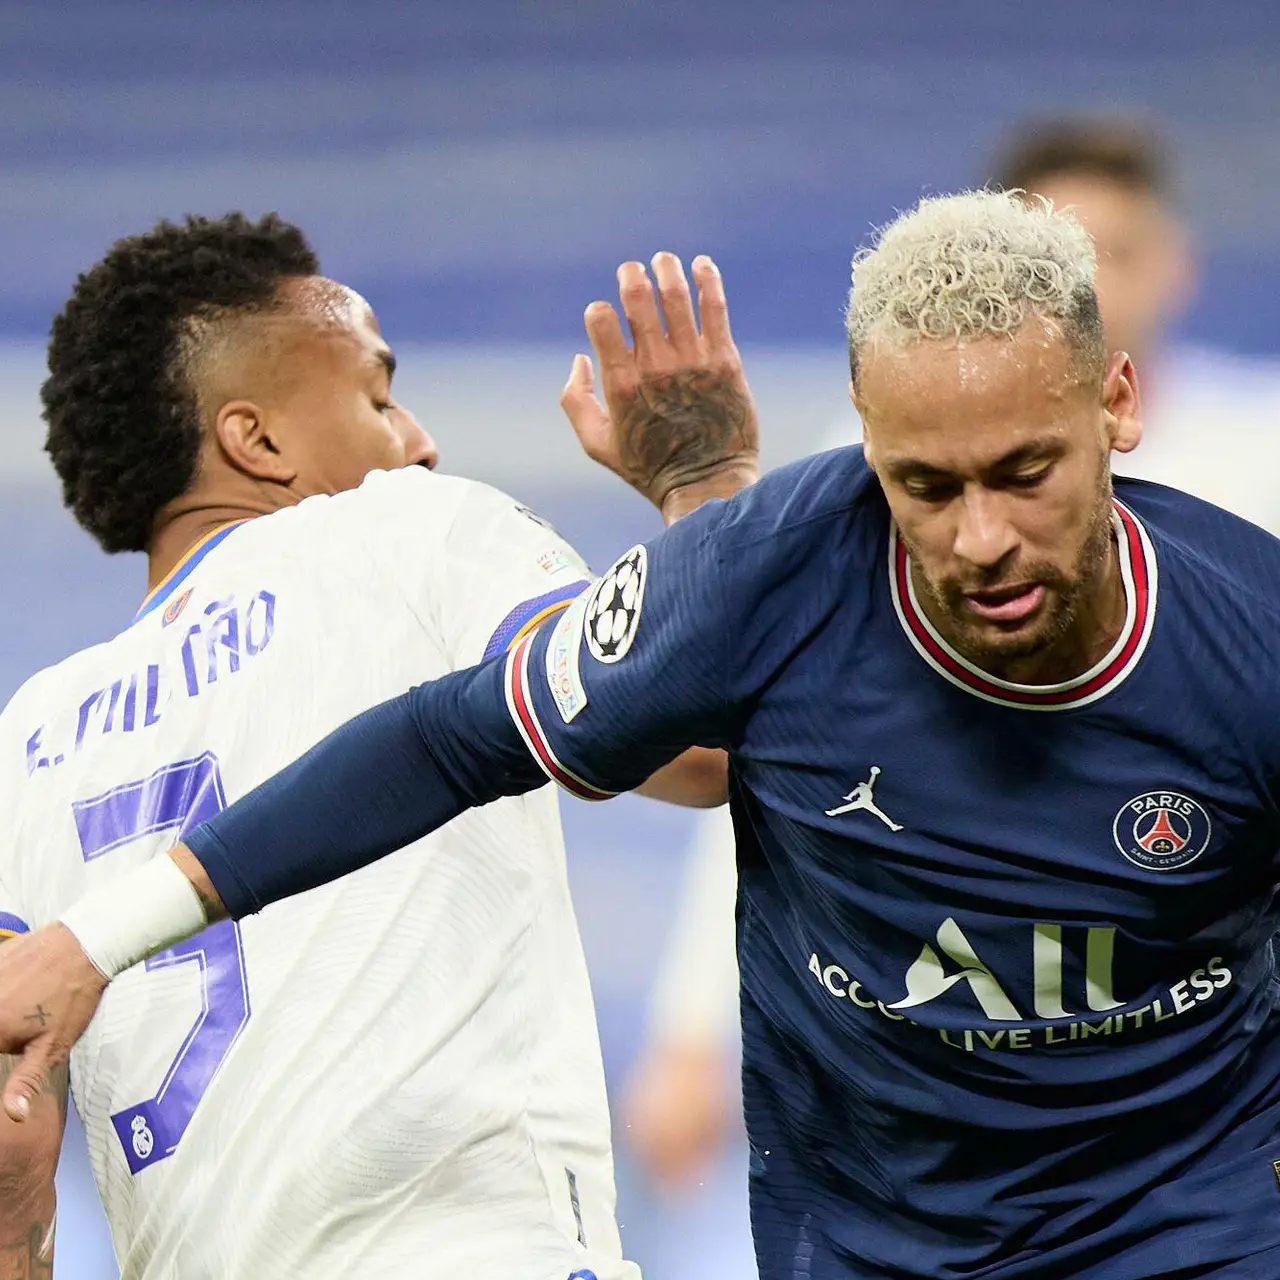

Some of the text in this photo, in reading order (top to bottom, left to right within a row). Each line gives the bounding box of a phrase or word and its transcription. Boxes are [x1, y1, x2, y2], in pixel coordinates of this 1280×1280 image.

[75, 589, 276, 753] MILTÃO
[1130, 794, 1196, 816] PARIS
[72, 750, 252, 1176] 3
[939, 1028, 1033, 1052] LIVE
[1045, 956, 1233, 1045] LIMITLESS
